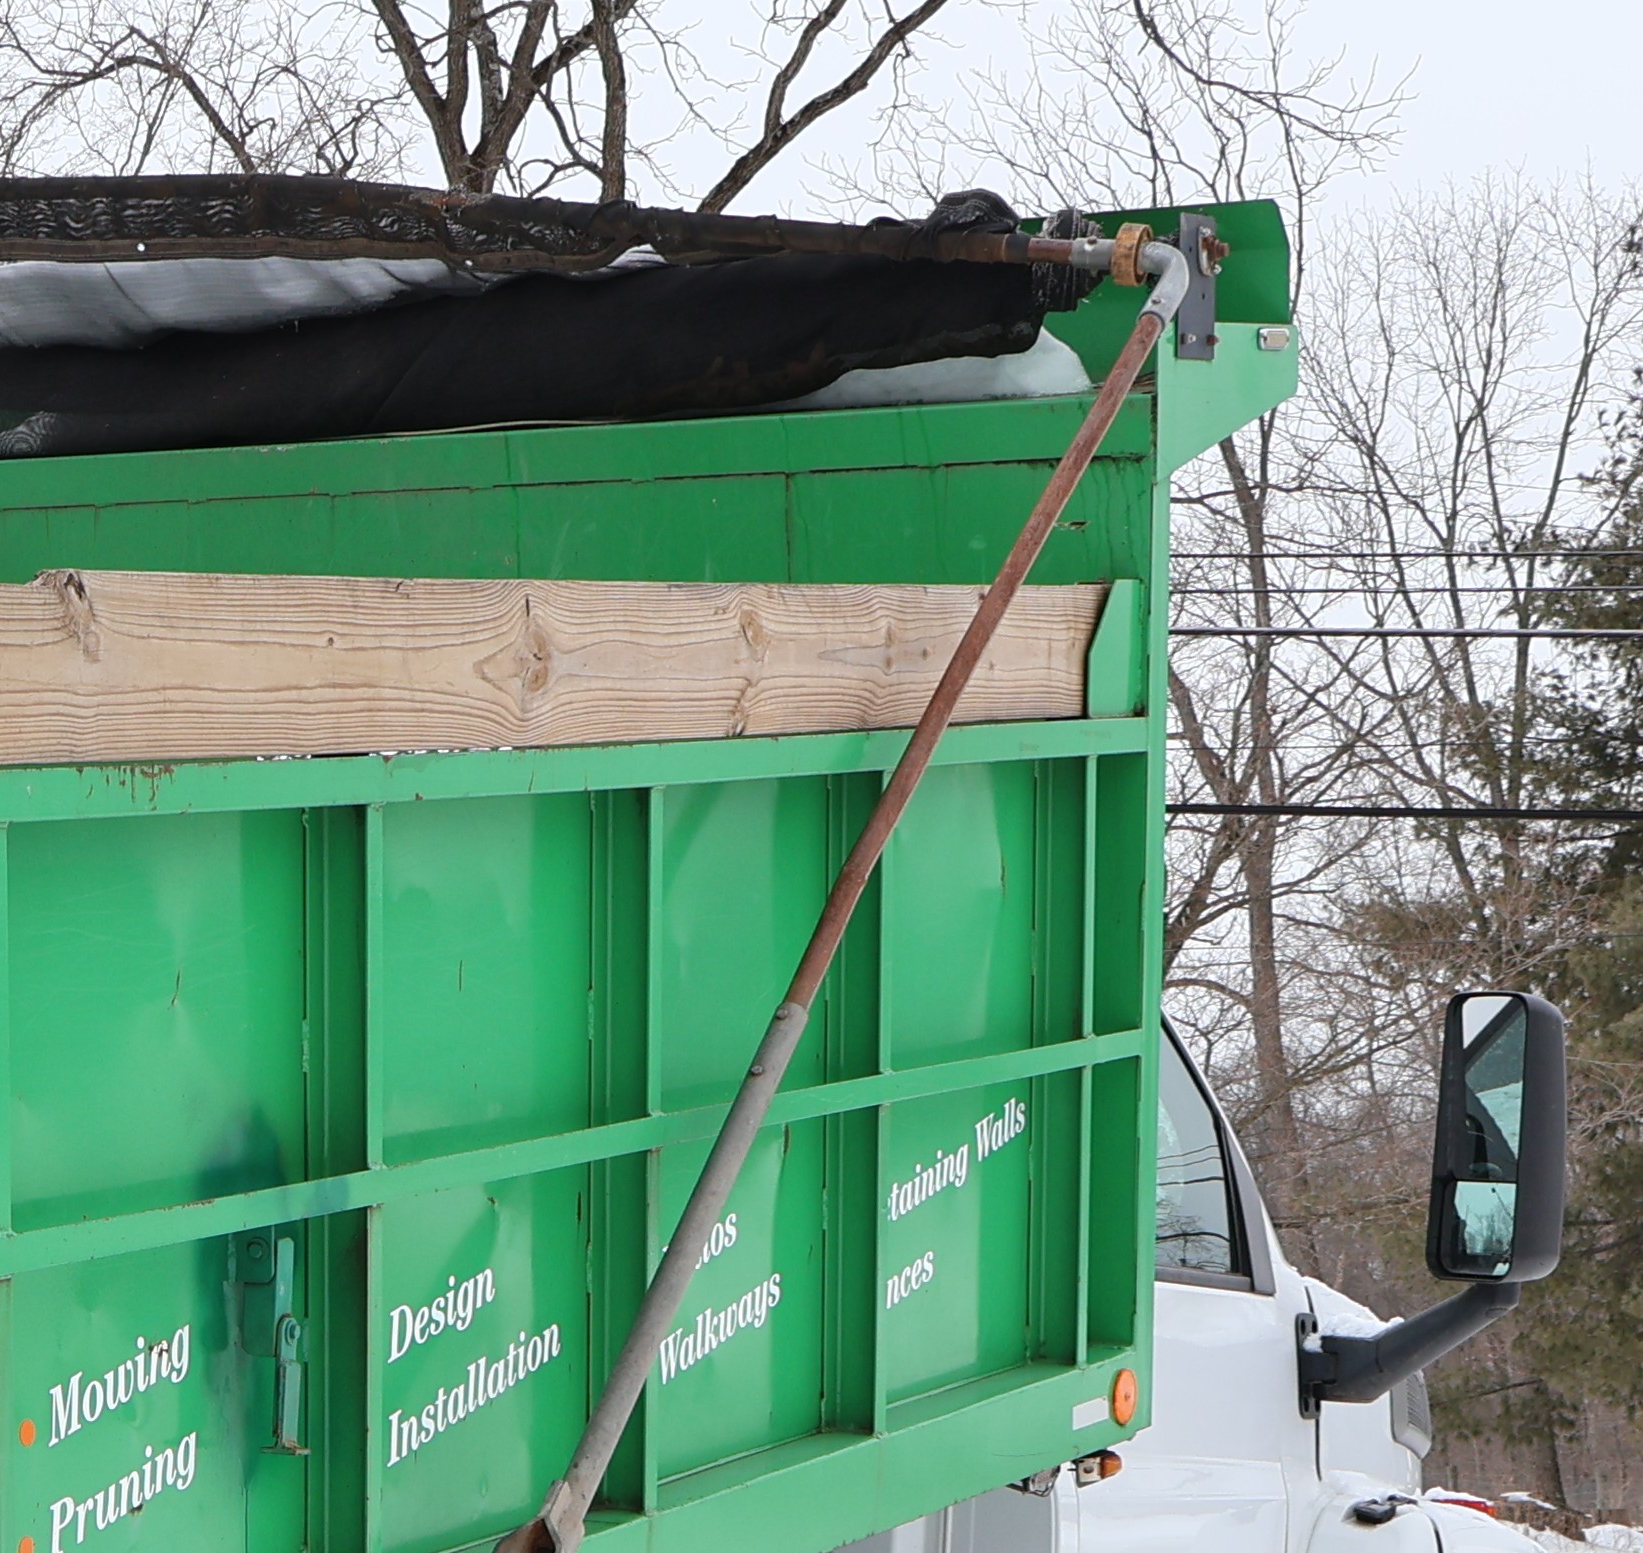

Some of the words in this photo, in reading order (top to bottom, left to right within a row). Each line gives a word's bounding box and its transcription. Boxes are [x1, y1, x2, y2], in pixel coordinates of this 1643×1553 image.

[887, 1144, 969, 1221] taining
[975, 1097, 1026, 1162] Walls
[387, 1268, 496, 1364] Design
[659, 1273, 781, 1385] Walkways
[886, 1251, 934, 1310] nces
[48, 1324, 190, 1447] Mowing
[387, 1324, 561, 1468] Installation
